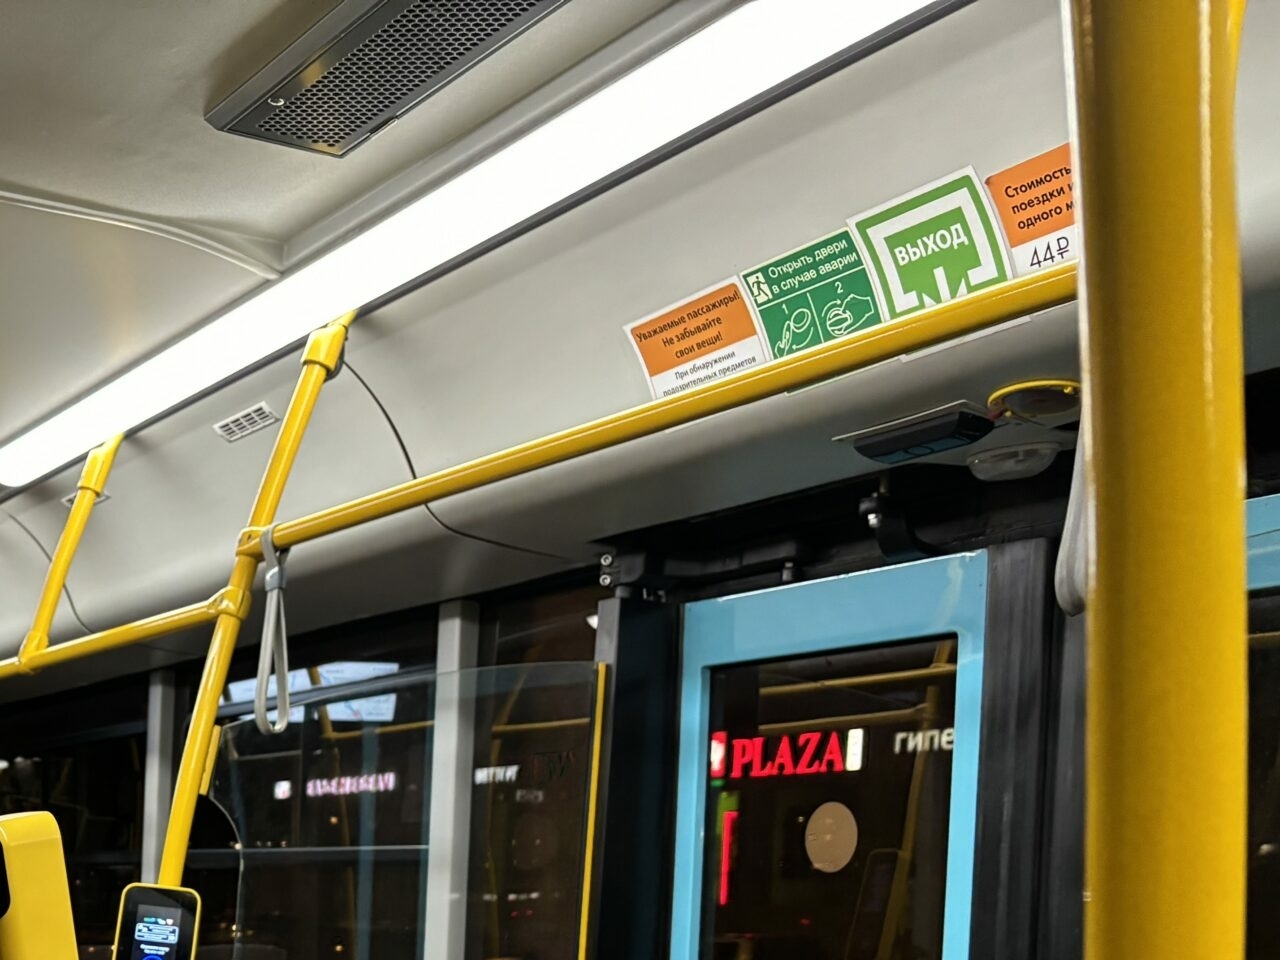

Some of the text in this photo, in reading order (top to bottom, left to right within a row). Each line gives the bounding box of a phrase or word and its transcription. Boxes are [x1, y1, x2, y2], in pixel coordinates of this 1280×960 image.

[1004, 165, 1072, 198] Стоимость
[1011, 184, 1066, 215] поездки
[1017, 204, 1063, 230] одного
[768, 239, 848, 278] Открыть двери
[893, 223, 969, 266] ВЫХОД
[771, 252, 858, 294] в случае аварии
[834, 281, 844, 294] 2
[636, 290, 740, 343] Уважаемые пассажиры!
[661, 315, 723, 348] Не забывайте
[675, 331, 723, 359] свои вещи!
[663, 356, 757, 397] подозрительных предметов
[675, 351, 736, 381] При обнаружении
[730, 731, 844, 778] PLAZA
